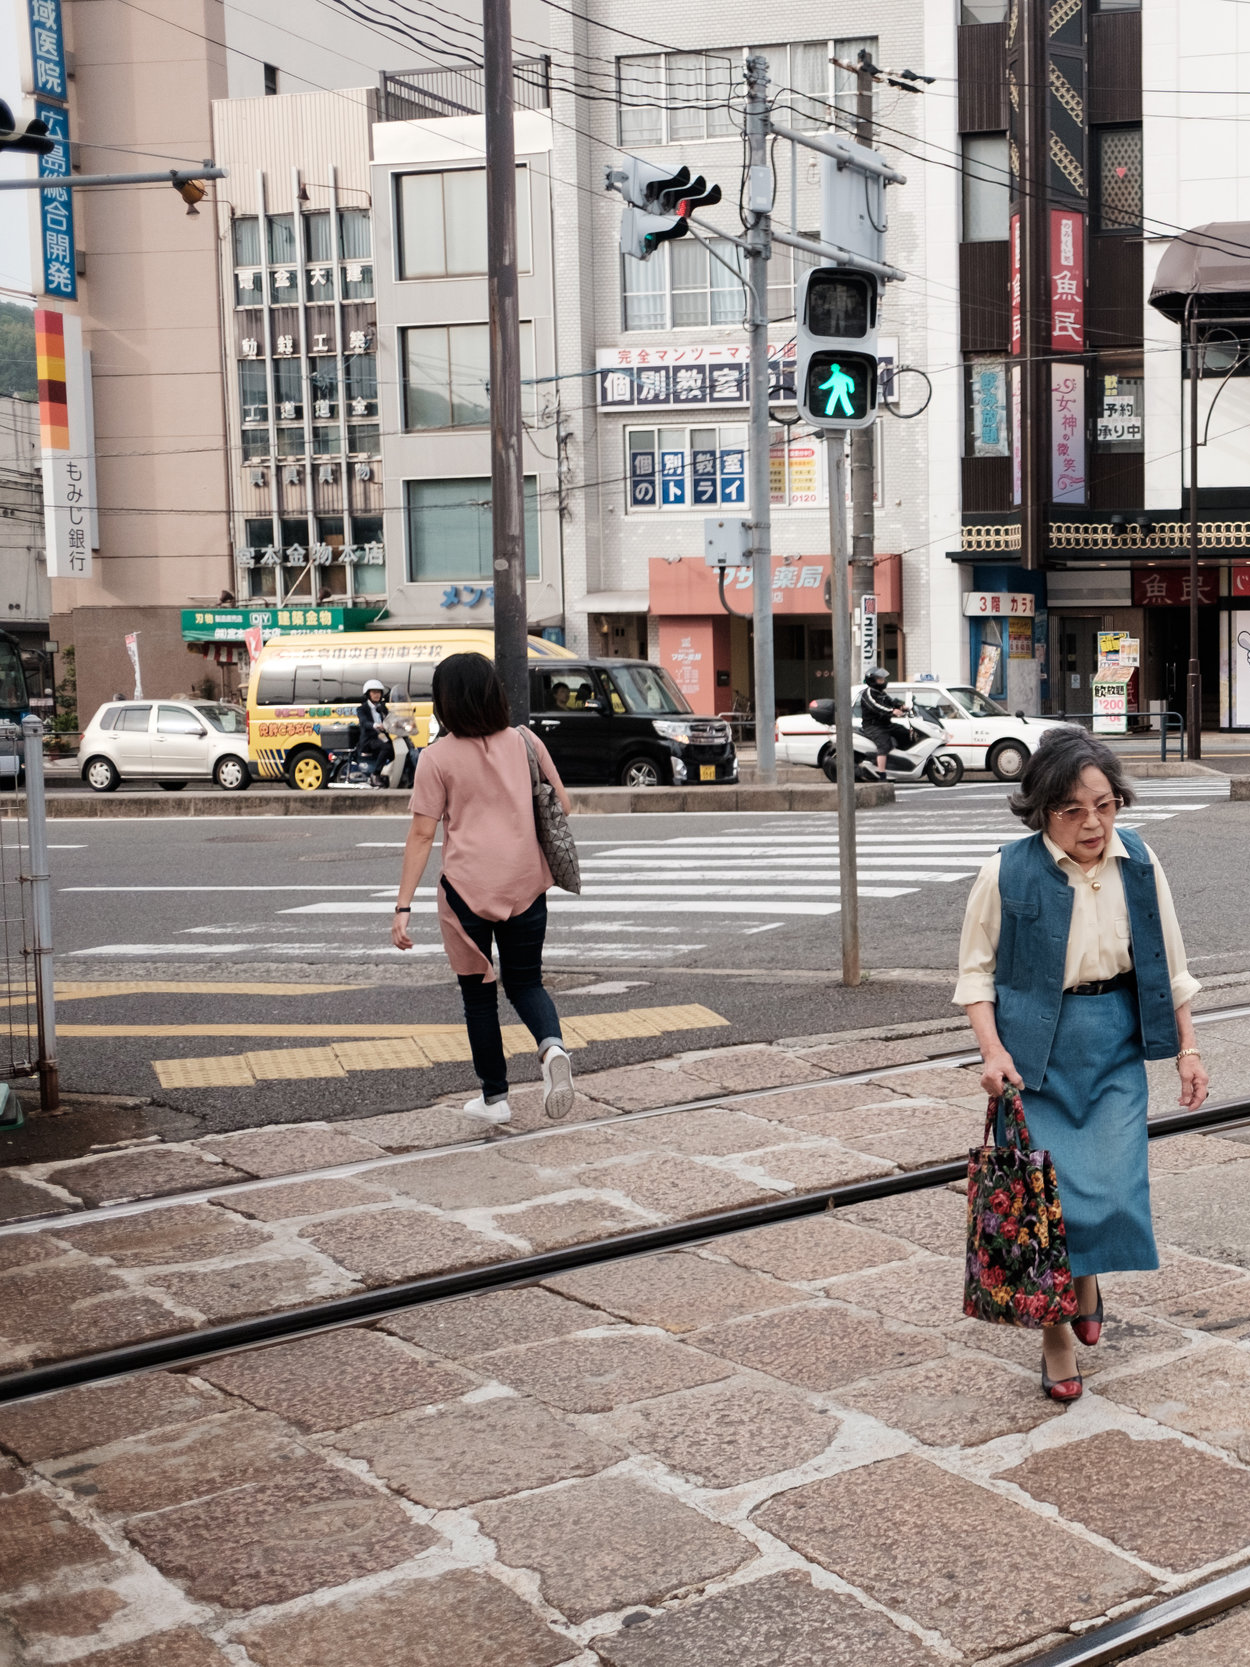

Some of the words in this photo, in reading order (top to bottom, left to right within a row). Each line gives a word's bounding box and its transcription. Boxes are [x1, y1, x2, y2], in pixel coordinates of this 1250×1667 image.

[1052, 270, 1082, 341] 魚民
[1104, 403, 1133, 417] 予約
[1056, 396, 1077, 473] 女神の微笑
[1099, 424, 1140, 439] 承り中
[66, 461, 86, 571] もみじ銀行
[441, 585, 494, 608] メン
[1142, 574, 1212, 604] 魚民
[980, 596, 1000, 612] 3階
[252, 614, 269, 624] DIY
[277, 611, 332, 626] 建築金物
[863, 617, 876, 660] ユニオン
